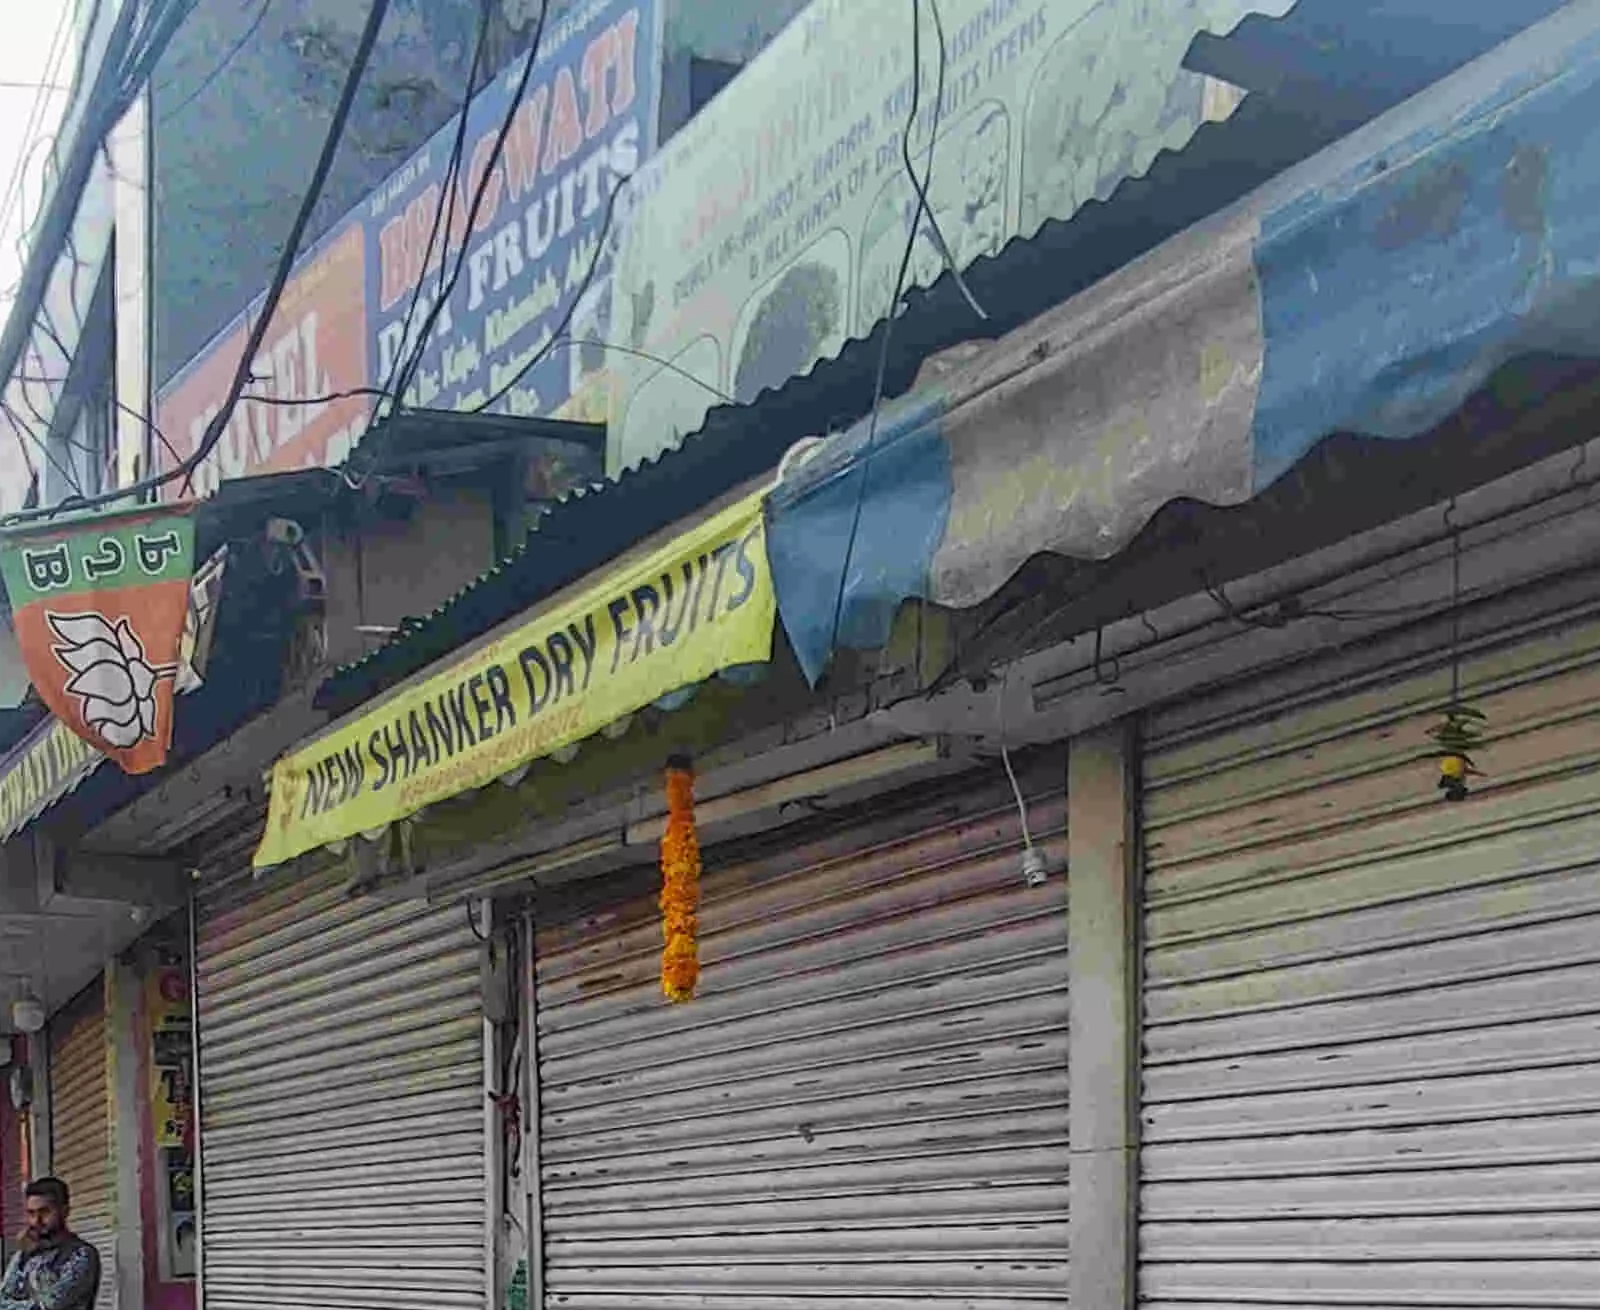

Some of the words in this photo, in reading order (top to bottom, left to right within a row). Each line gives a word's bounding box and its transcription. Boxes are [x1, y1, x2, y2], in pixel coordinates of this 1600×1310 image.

[466, 115, 640, 311] FRUITS
[301, 741, 366, 819] NEW
[367, 664, 516, 792] SHANKER
[517, 612, 597, 719] DRY
[608, 527, 760, 675] FRUITS
